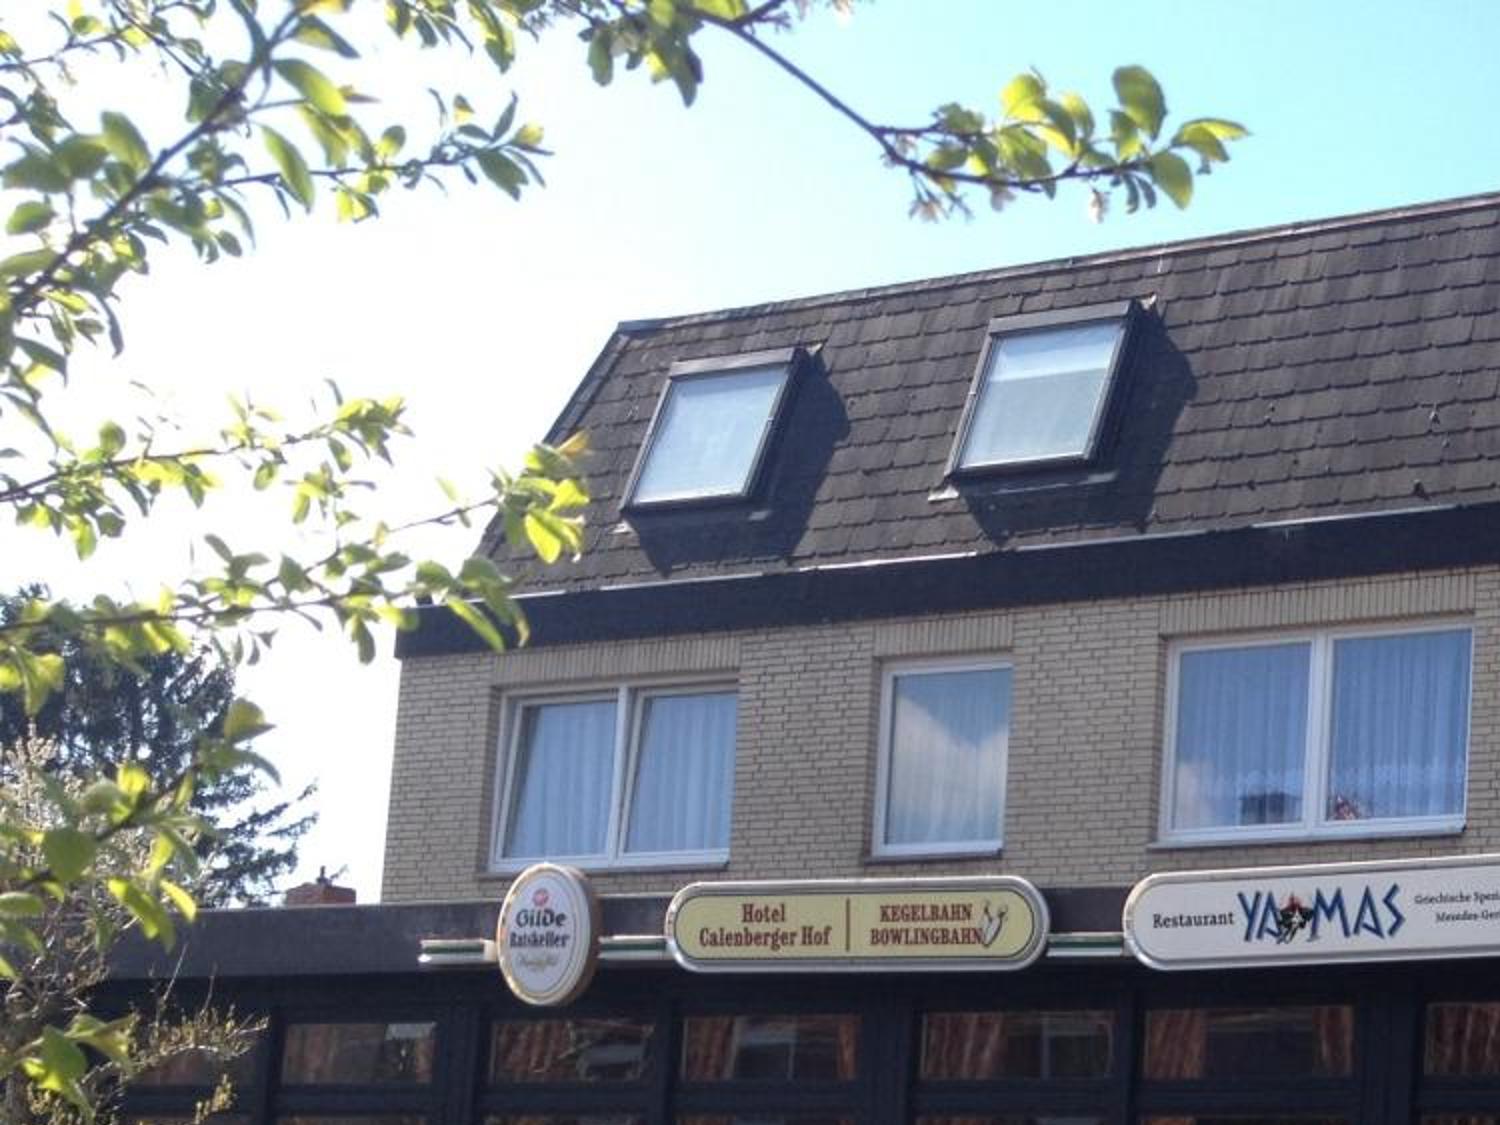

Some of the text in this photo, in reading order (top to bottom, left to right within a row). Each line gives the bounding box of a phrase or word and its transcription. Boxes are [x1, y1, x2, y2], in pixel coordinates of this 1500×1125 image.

[1414, 891, 1472, 904] Griechische
[516, 908, 568, 928] Gilde
[742, 903, 785, 923] Hotel
[879, 904, 973, 922] KEGELBAHN
[1152, 911, 1235, 930] Restaurant
[510, 931, 570, 948] Ratskeller
[700, 926, 832, 951] Calenberger Hof
[870, 927, 984, 945] BOWLINGBAHN
